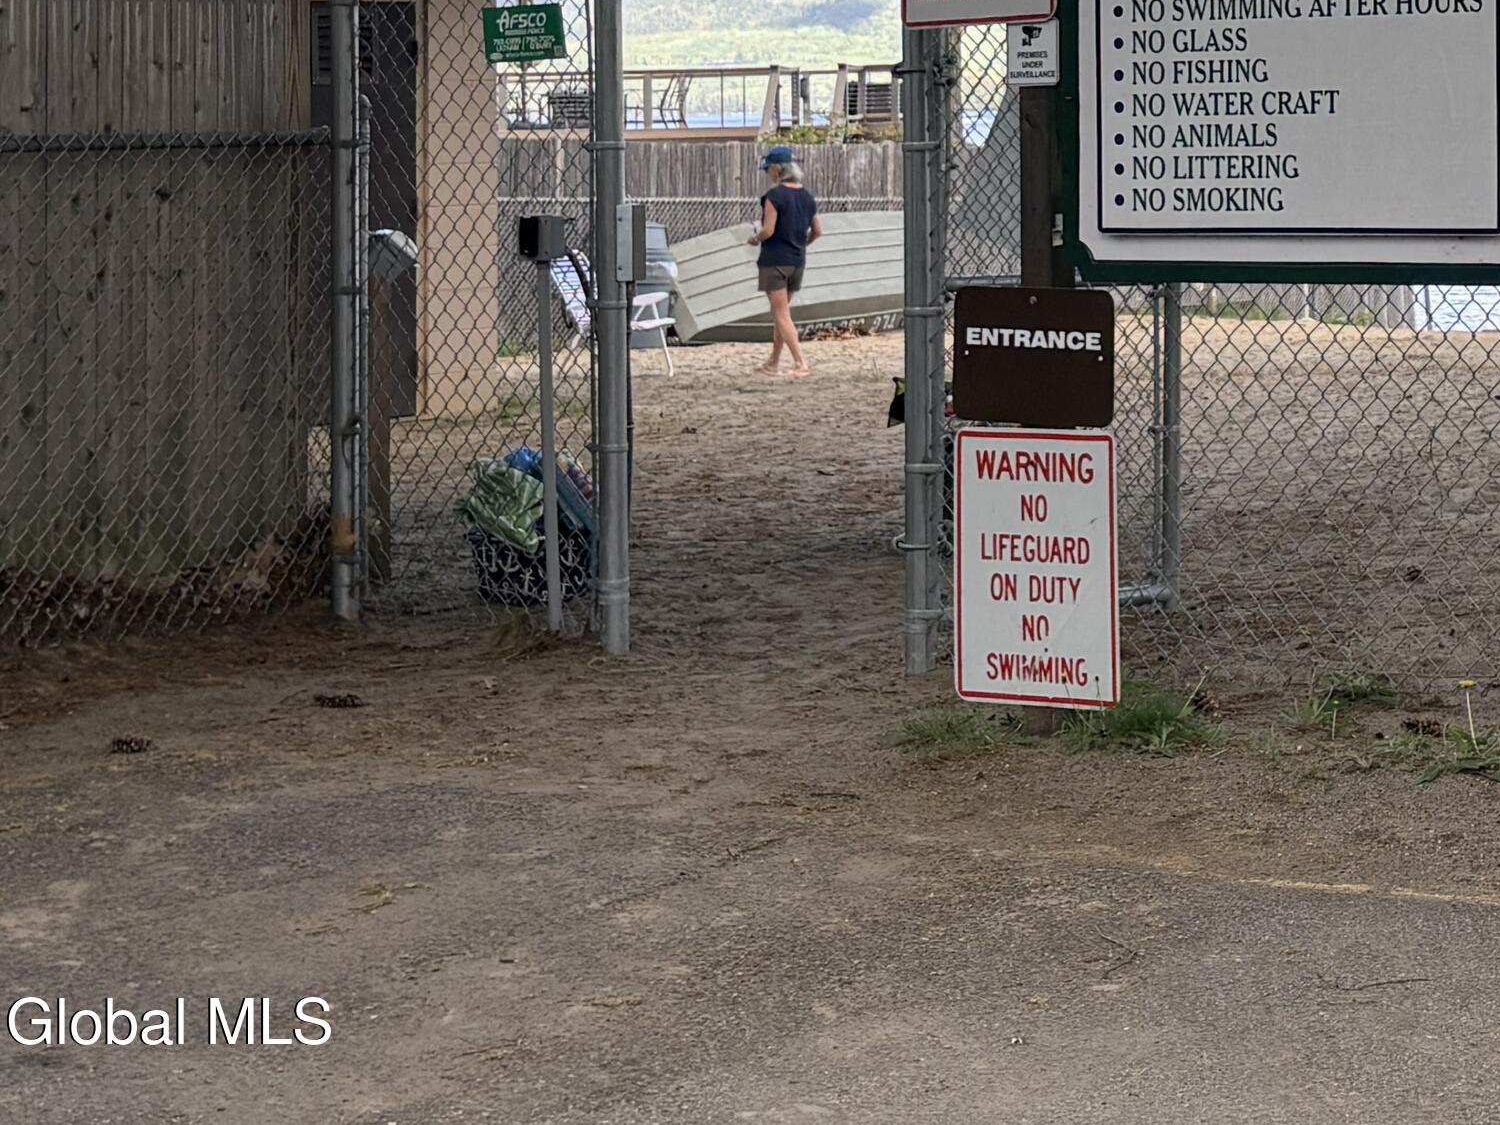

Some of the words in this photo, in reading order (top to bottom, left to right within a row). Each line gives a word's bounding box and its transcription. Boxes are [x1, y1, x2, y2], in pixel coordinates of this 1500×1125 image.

[496, 10, 547, 32] AFSCO
[1131, 30, 1165, 54] NO
[1173, 27, 1248, 53] GLASS
[1131, 61, 1165, 85] NO
[1172, 58, 1269, 84] FISHING
[1131, 92, 1165, 117] NO
[1172, 91, 1255, 117] WATER
[1261, 89, 1340, 115] CRAFT
[1131, 124, 1165, 148] NO
[1172, 123, 1278, 148] ANIMALS
[1131, 156, 1165, 180] NO
[1173, 154, 1299, 180] LITTERING
[1131, 188, 1165, 212] NO
[1173, 187, 1284, 212] SMOKING
[966, 327, 1102, 351] ENTRANCE
[976, 450, 1094, 484] WARNING
[1020, 494, 1047, 522] NO
[981, 533, 1090, 565] LIFEGUARD
[990, 573, 1017, 602] ON
[1029, 575, 1081, 604] DUTY
[1022, 614, 1049, 642] NO
[986, 652, 1088, 687] SWIMMING
